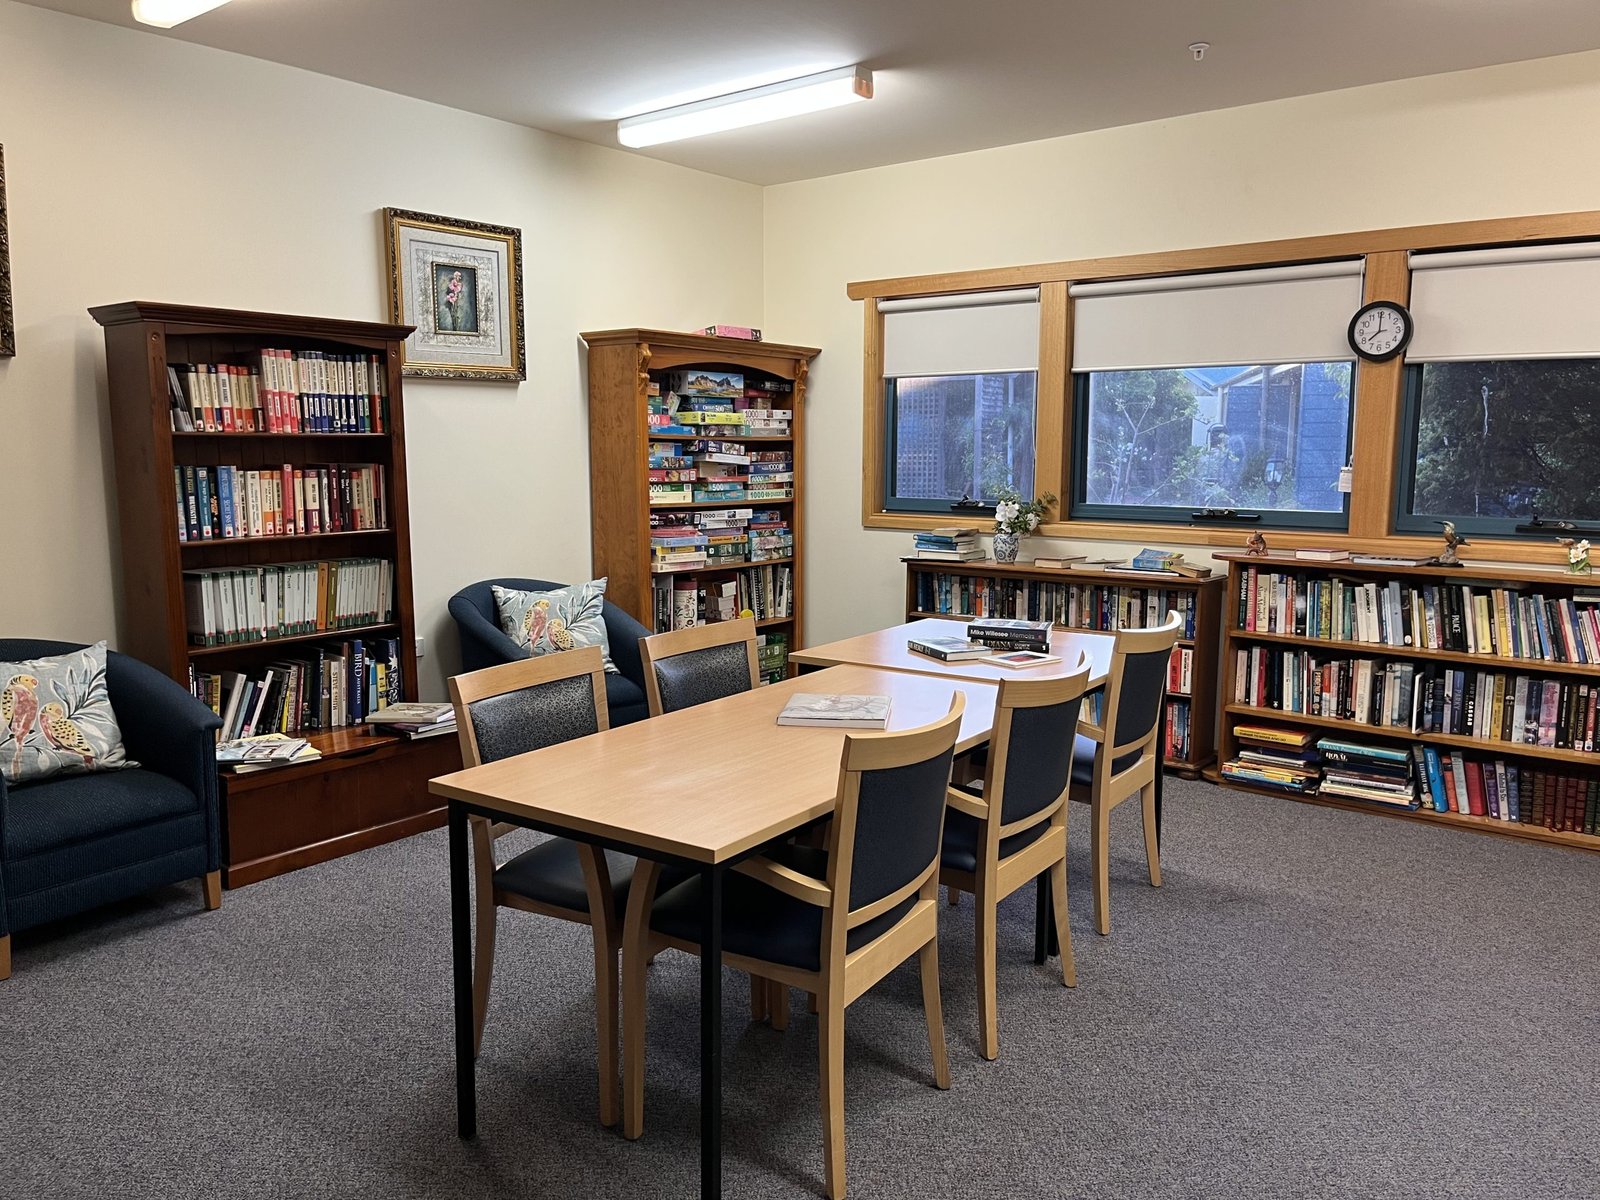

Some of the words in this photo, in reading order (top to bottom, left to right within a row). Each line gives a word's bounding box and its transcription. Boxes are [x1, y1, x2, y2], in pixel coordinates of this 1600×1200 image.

[745, 410, 758, 418] 1000
[354, 653, 362, 677] BIRD
[288, 692, 296, 728] PIETERSEN
[1577, 713, 1585, 739] PATTERSON
